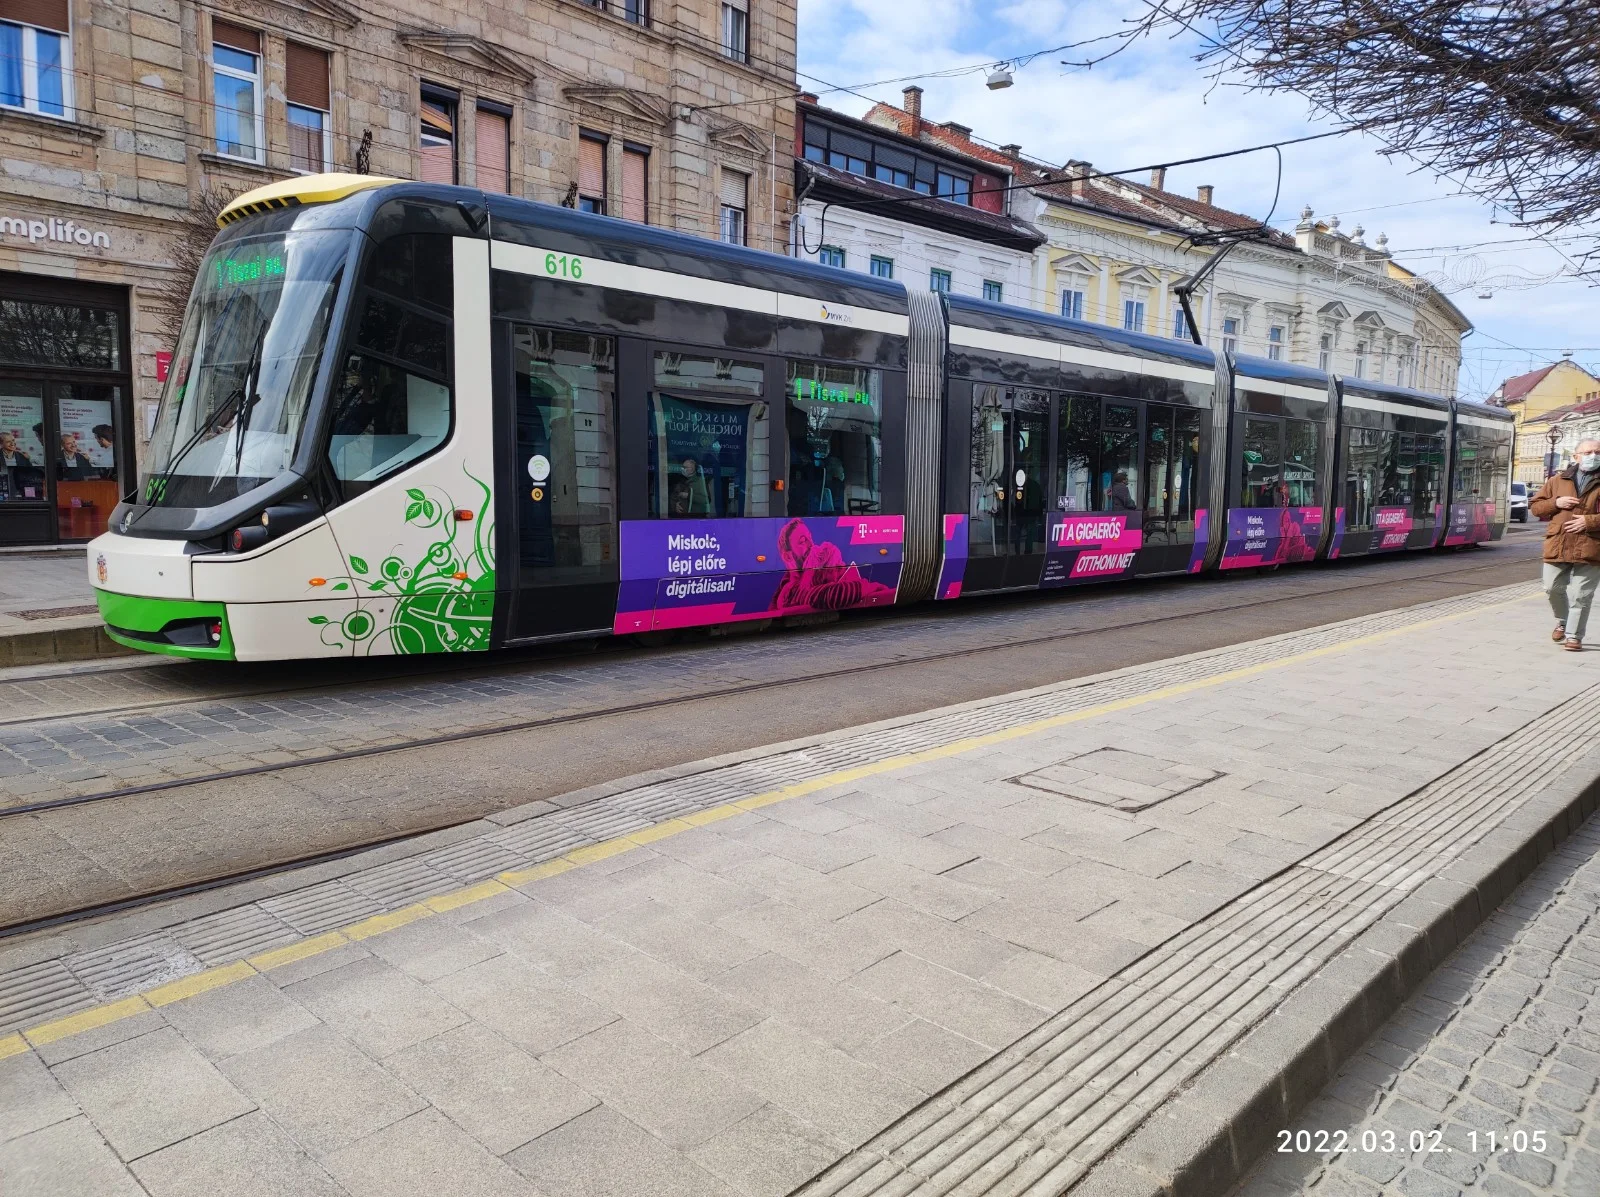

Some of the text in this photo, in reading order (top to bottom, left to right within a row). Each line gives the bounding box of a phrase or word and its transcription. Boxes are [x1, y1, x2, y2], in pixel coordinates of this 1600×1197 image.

[545, 253, 582, 279] 616
[830, 312, 843, 322] MVK
[809, 379, 849, 403] Tiszai
[854, 389, 873, 406] pu.
[1051, 517, 1121, 542] ITT A GIGAERŐS
[668, 533, 721, 551] Miskolc,
[668, 553, 726, 575] lépj előre
[1076, 553, 1117, 573] OTTHONI
[1115, 552, 1136, 569] NET
[666, 576, 736, 599] digitálisan!
